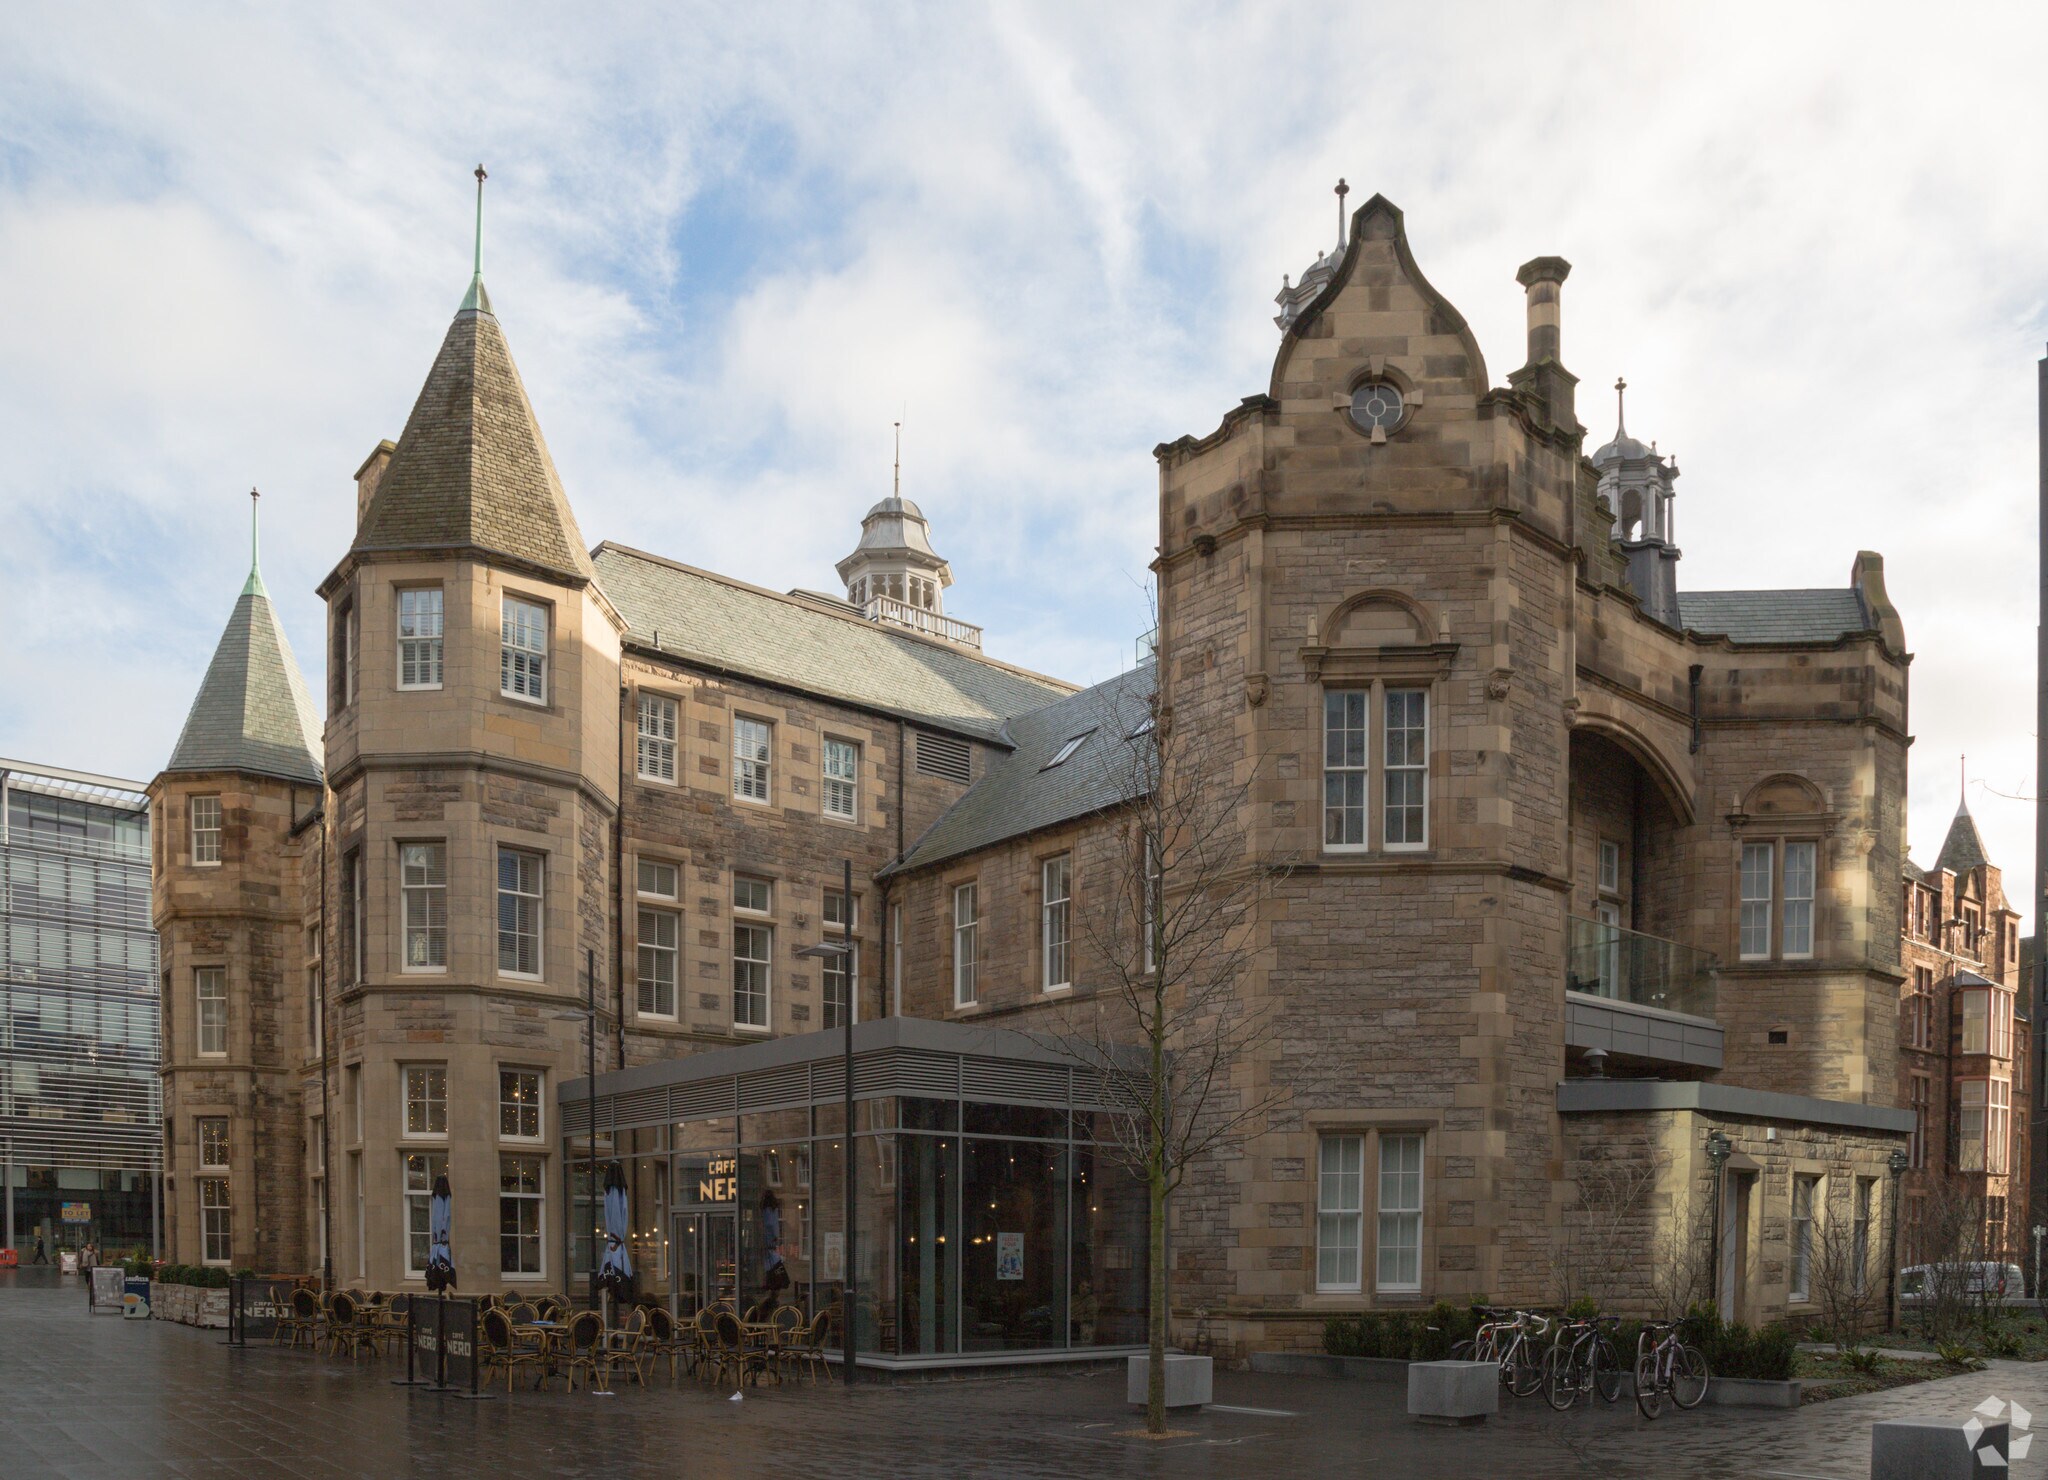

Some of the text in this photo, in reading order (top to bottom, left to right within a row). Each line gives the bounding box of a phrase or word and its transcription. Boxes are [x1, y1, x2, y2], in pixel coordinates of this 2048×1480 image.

[708, 1159, 736, 1175] CAFF
[700, 1177, 737, 1202] NER
[418, 1335, 437, 1351] NERO
[447, 1340, 472, 1357] NERO
